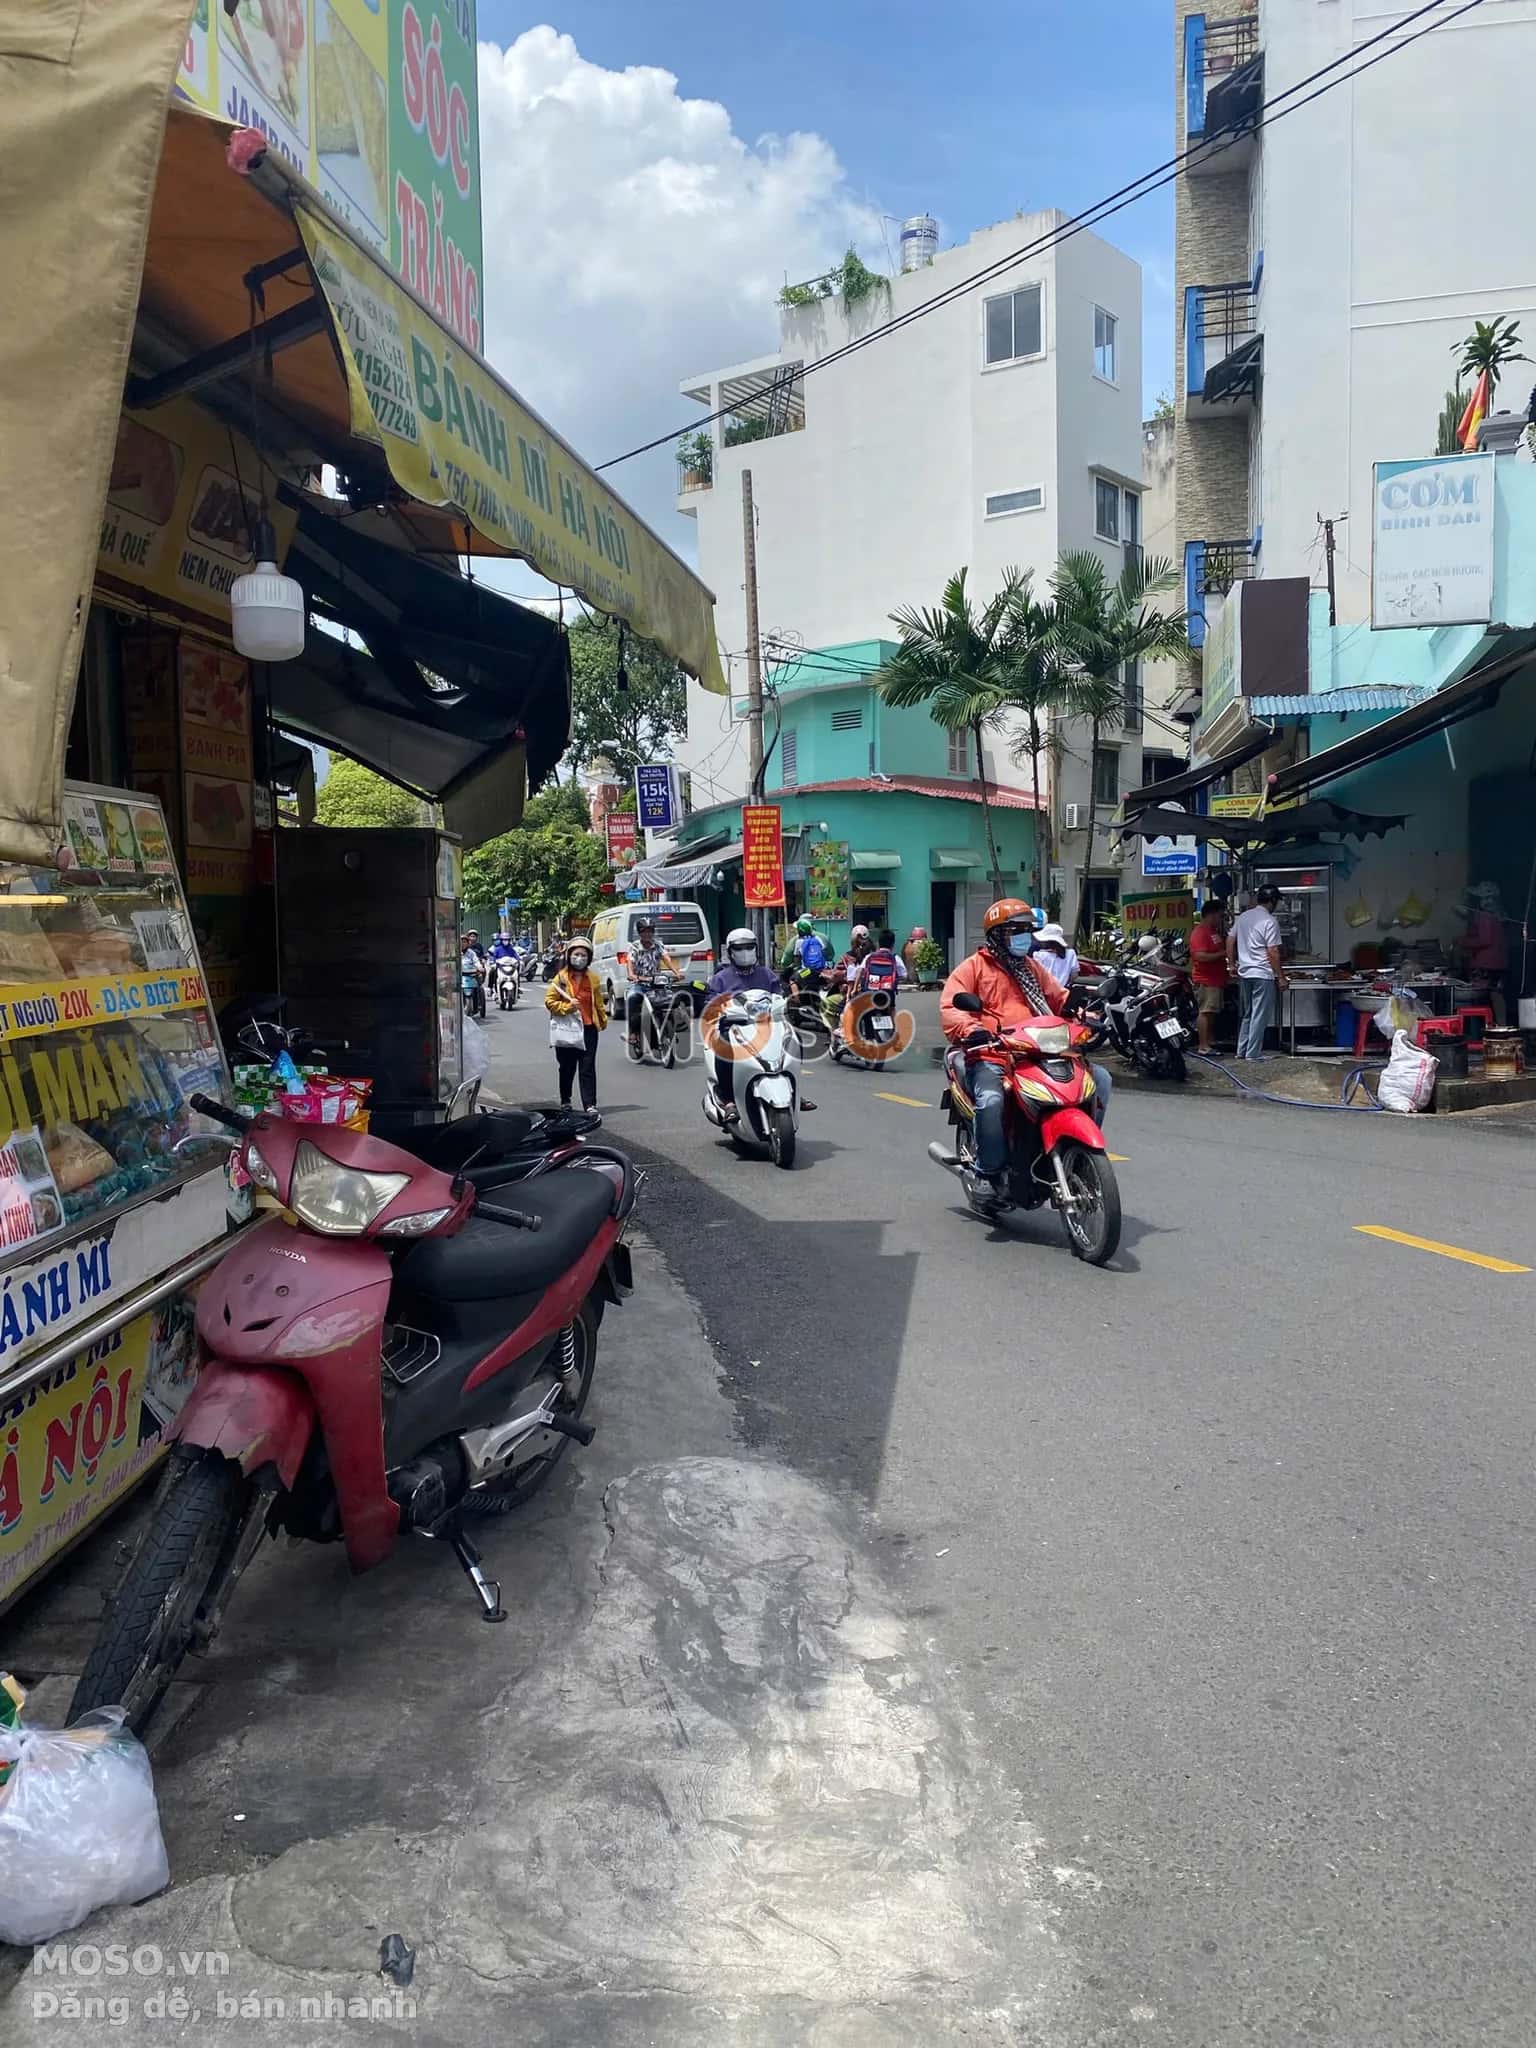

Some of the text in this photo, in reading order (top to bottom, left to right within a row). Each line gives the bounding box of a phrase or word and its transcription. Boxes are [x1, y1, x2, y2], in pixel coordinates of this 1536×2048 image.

[367, 391, 418, 440] 077243
[412, 332, 511, 482] BÁNH
[518, 436, 553, 516] MÌ
[558, 471, 591, 546] HÀ
[179, 551, 238, 595] NEM CHU
[641, 783, 668, 797] 15k
[13, 992, 60, 1029] NGUỘI
[61, 988, 94, 1020] 20K
[101, 979, 142, 1018] ĐẶC
[144, 975, 180, 1011] BIỆT
[268, 1246, 308, 1264] HONDA
[0, 1261, 72, 1354] ÁNH
[40, 1365, 133, 1484] NỘI
